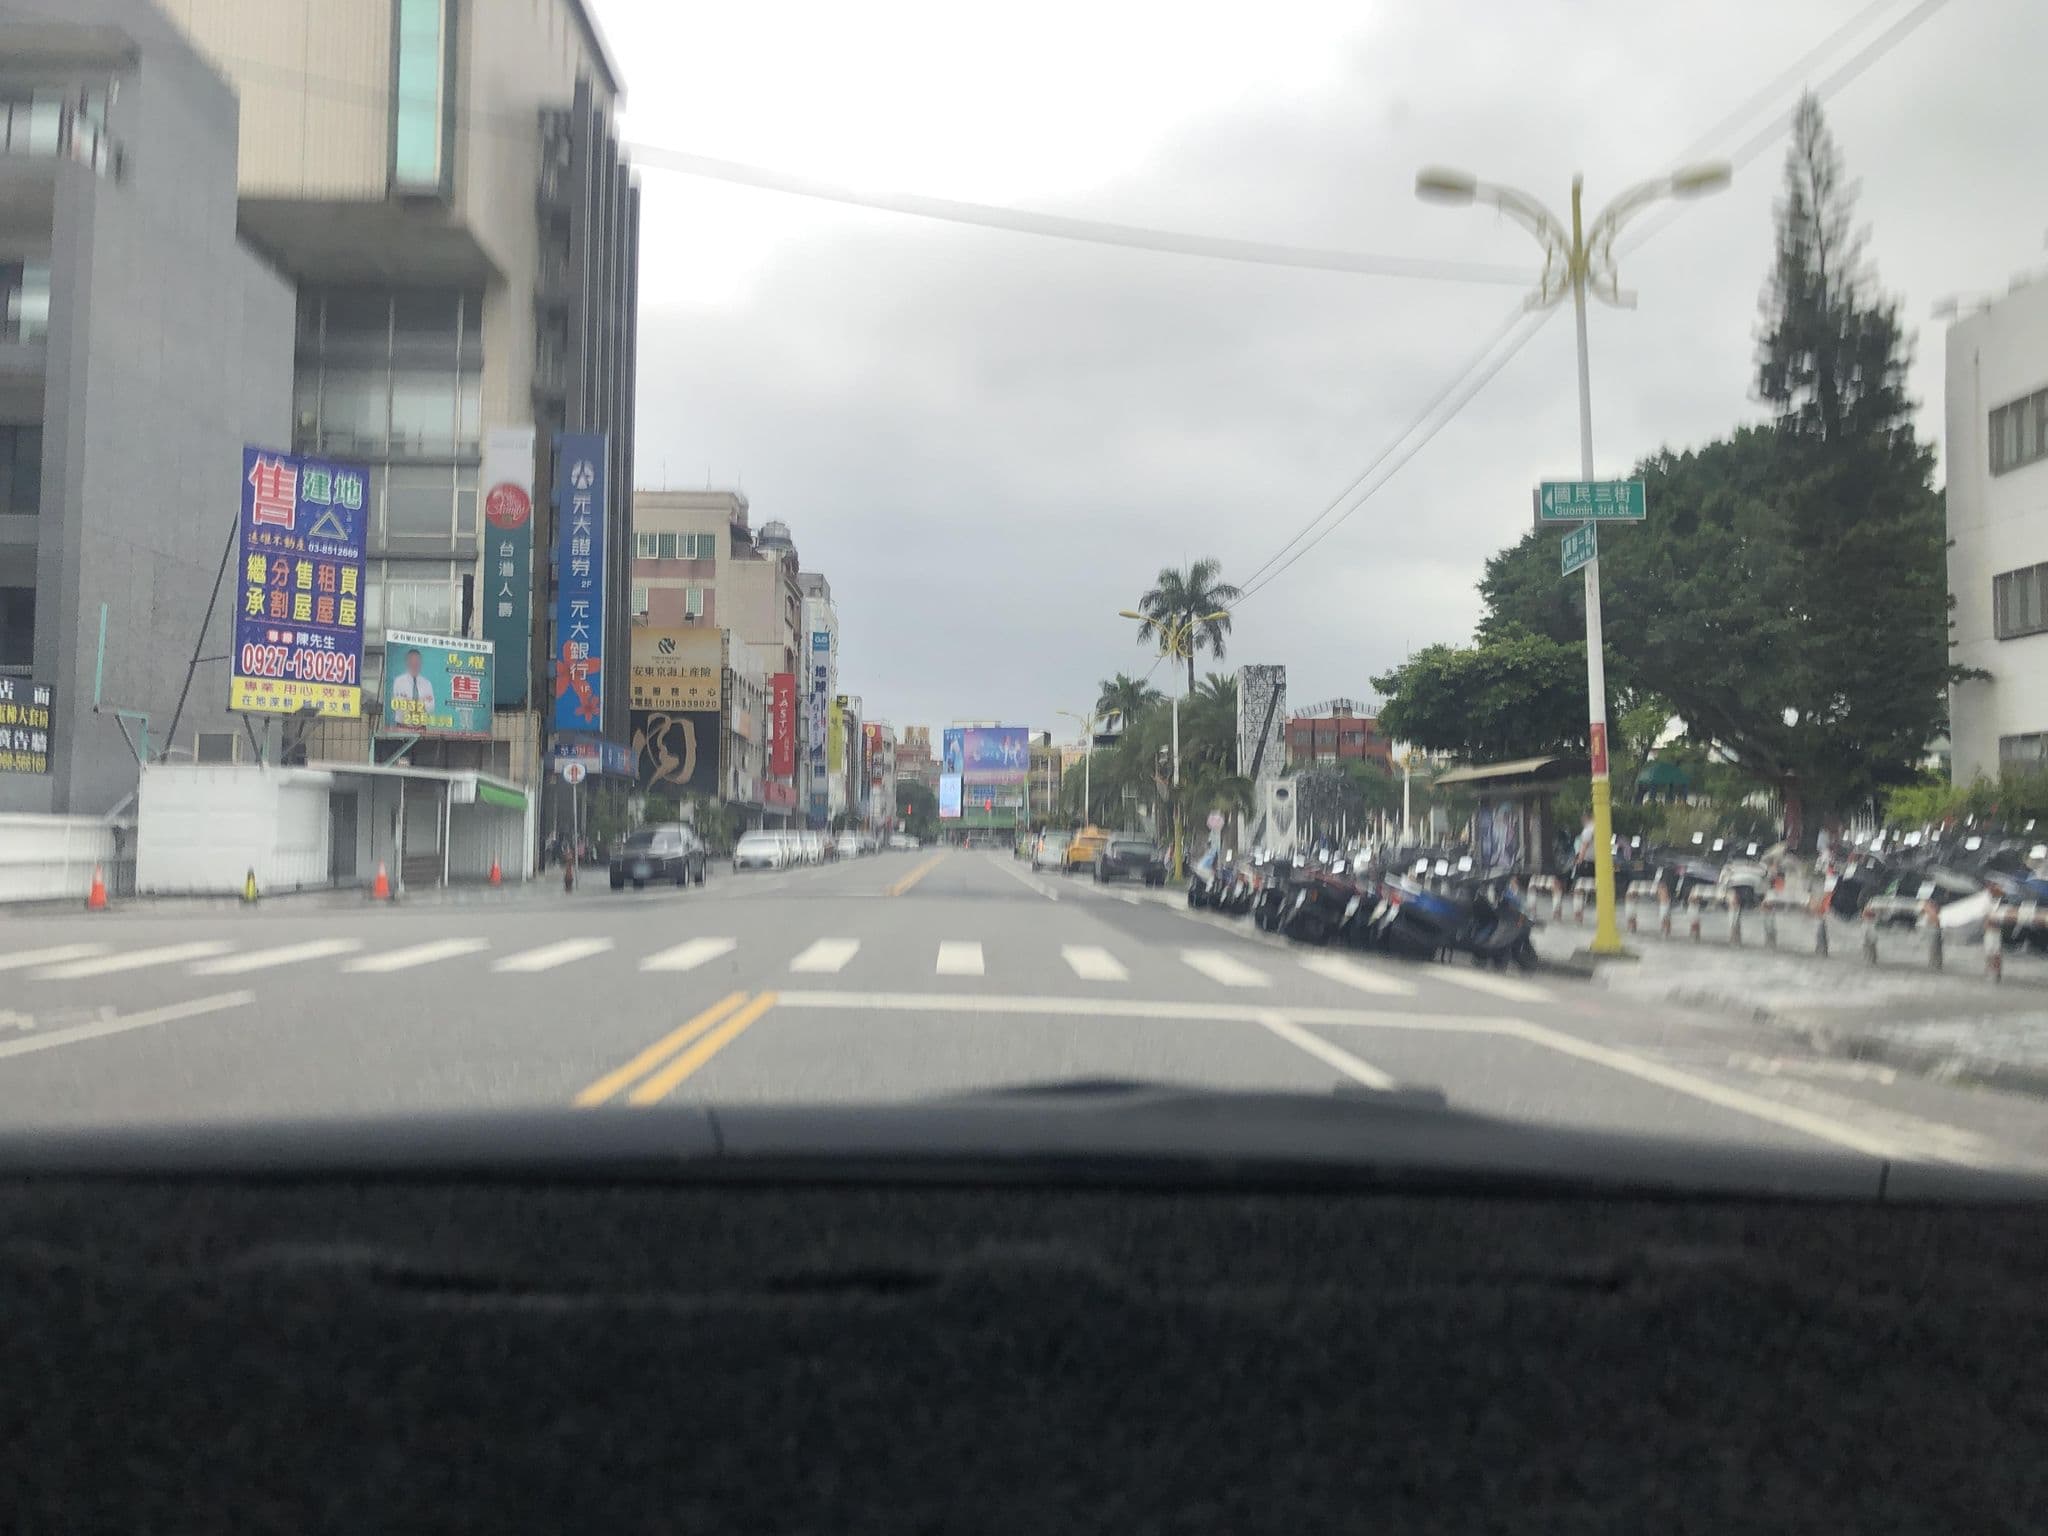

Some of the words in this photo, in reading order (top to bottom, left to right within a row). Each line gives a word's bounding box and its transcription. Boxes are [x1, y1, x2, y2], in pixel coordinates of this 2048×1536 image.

[248, 453, 298, 530] 售
[302, 466, 362, 510] 建地
[1554, 484, 1631, 503] 國民三街
[1554, 505, 1593, 515] Guomin
[1598, 503, 1614, 515] 3rd
[572, 494, 591, 577] 元大證券
[498, 541, 514, 617] 台灣人壽
[296, 631, 335, 649] 陳先生
[570, 600, 590, 680] 元大銀行
[242, 643, 356, 684] 0927-130291
[451, 674, 481, 702] 售
[779, 689, 788, 740] TASTY
